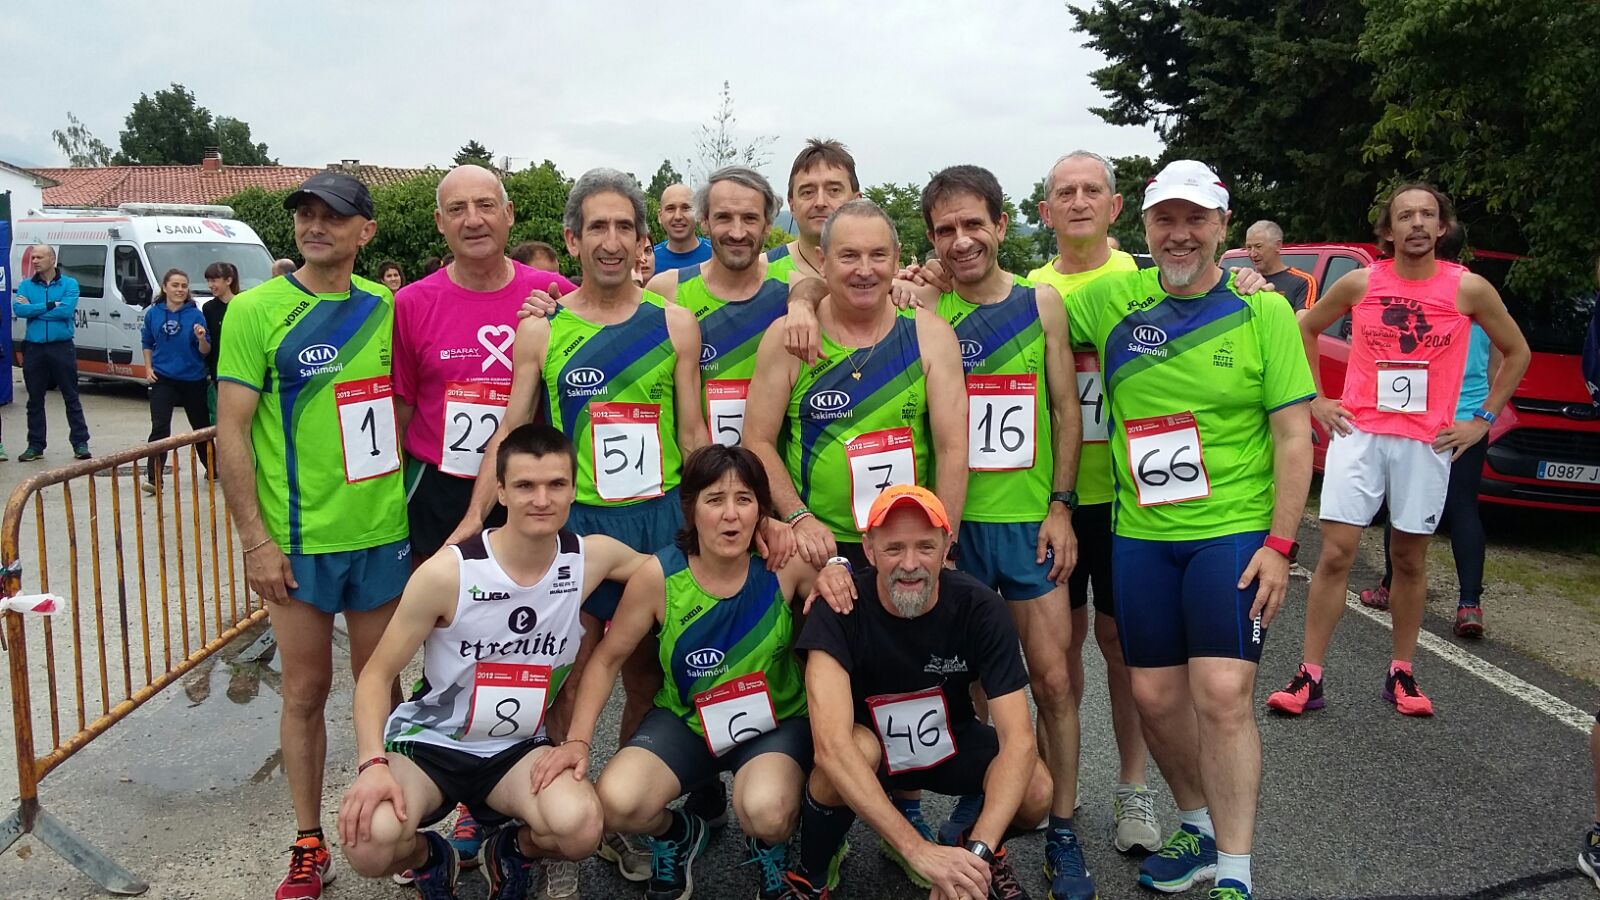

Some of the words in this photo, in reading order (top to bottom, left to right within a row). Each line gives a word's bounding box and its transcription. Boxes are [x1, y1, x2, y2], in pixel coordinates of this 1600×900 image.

[164, 225, 202, 235] SAMU
[283, 300, 310, 327] Joma
[1138, 328, 1160, 341] KIA
[450, 347, 479, 355] SARAY
[562, 335, 585, 357] Joma
[961, 343, 976, 355] IA
[1127, 343, 1168, 358] Sakimóvil
[305, 347, 335, 363] KIA
[300, 362, 344, 378] Sakimóvil
[571, 371, 600, 384] KIA
[810, 360, 833, 379] Joma
[336, 391, 351, 399] 2012
[566, 386, 608, 397] Sakimóvil
[1391, 375, 1412, 408] 9
[816, 394, 844, 407] KIA
[810, 409, 853, 420] Sakimóvil
[361, 406, 381, 456] 1
[449, 412, 499, 453] 22
[717, 414, 743, 447] 5
[977, 402, 1025, 454] 16
[603, 434, 645, 475] 51
[1137, 445, 1199, 486] 66
[1547, 464, 1584, 480] 0987
[1589, 468, 1599, 481] J
[868, 464, 893, 494] 7
[473, 591, 511, 602] LUGA
[679, 605, 703, 626] Joma
[691, 652, 720, 665] KIA
[686, 665, 730, 678] Sakimóvil
[488, 698, 521, 738] 8
[728, 711, 762, 744] 6
[886, 709, 941, 755] 46
